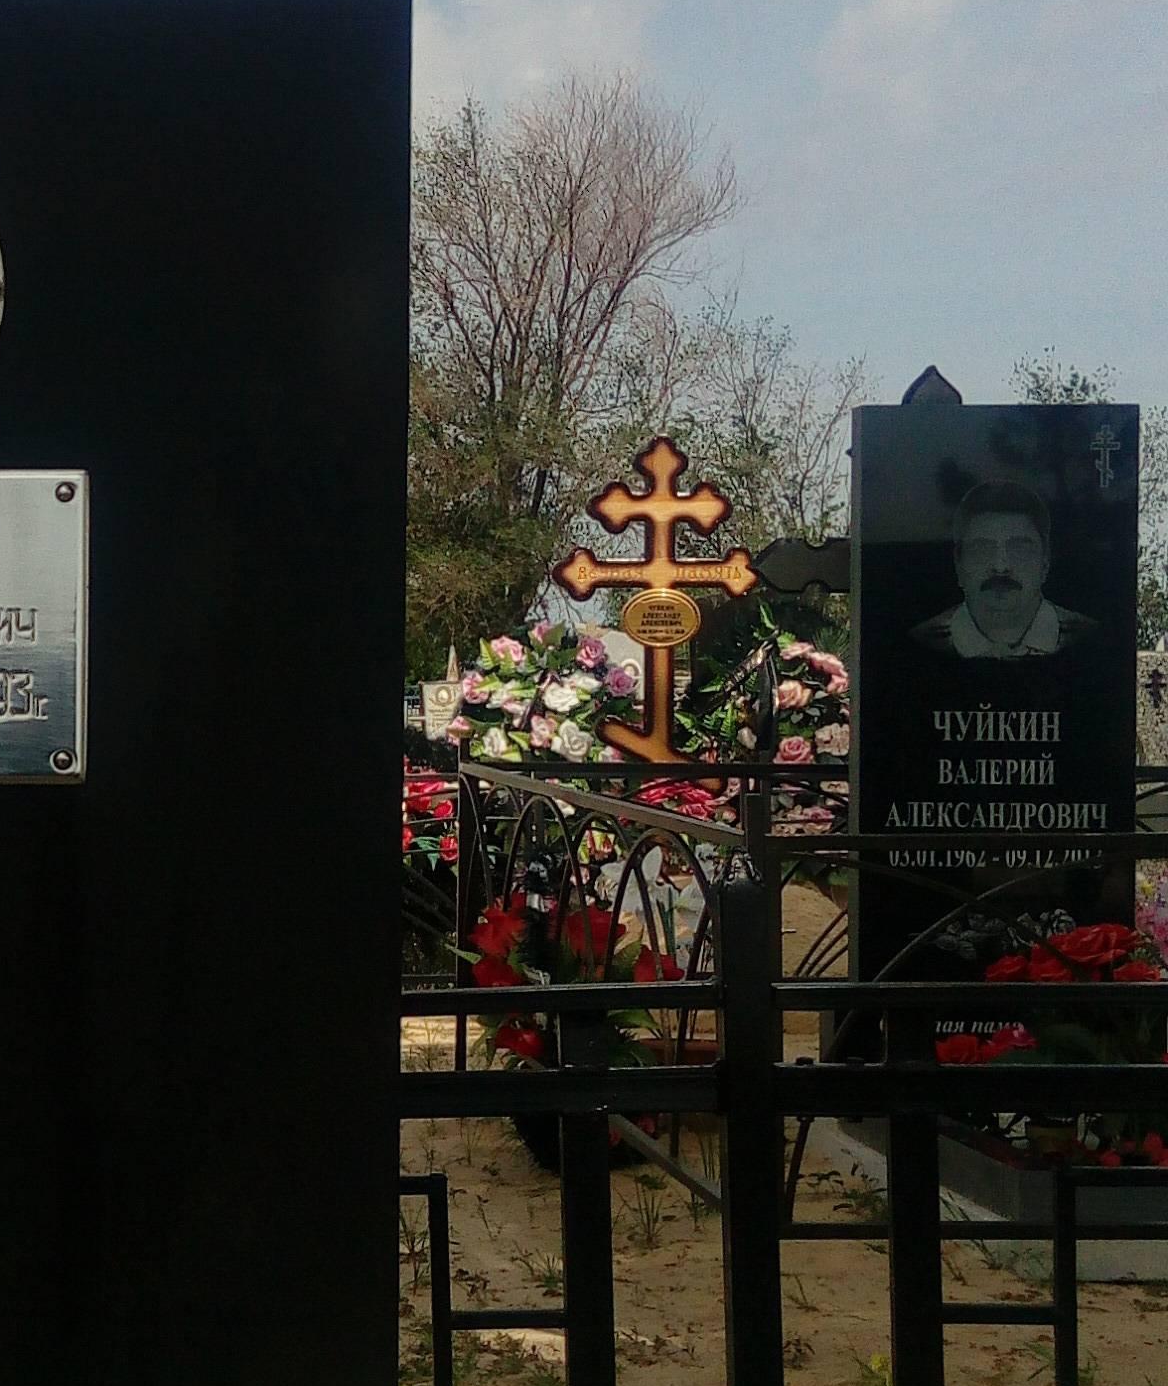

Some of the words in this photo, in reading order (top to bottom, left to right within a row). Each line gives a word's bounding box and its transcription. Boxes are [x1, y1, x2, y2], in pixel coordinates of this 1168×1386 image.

[933, 702, 1061, 742] ЧУЙКИН
[938, 752, 1055, 785] ВАЛЕРИЙ
[884, 801, 1109, 832] АЛЕКСАНДРОВИЧ
